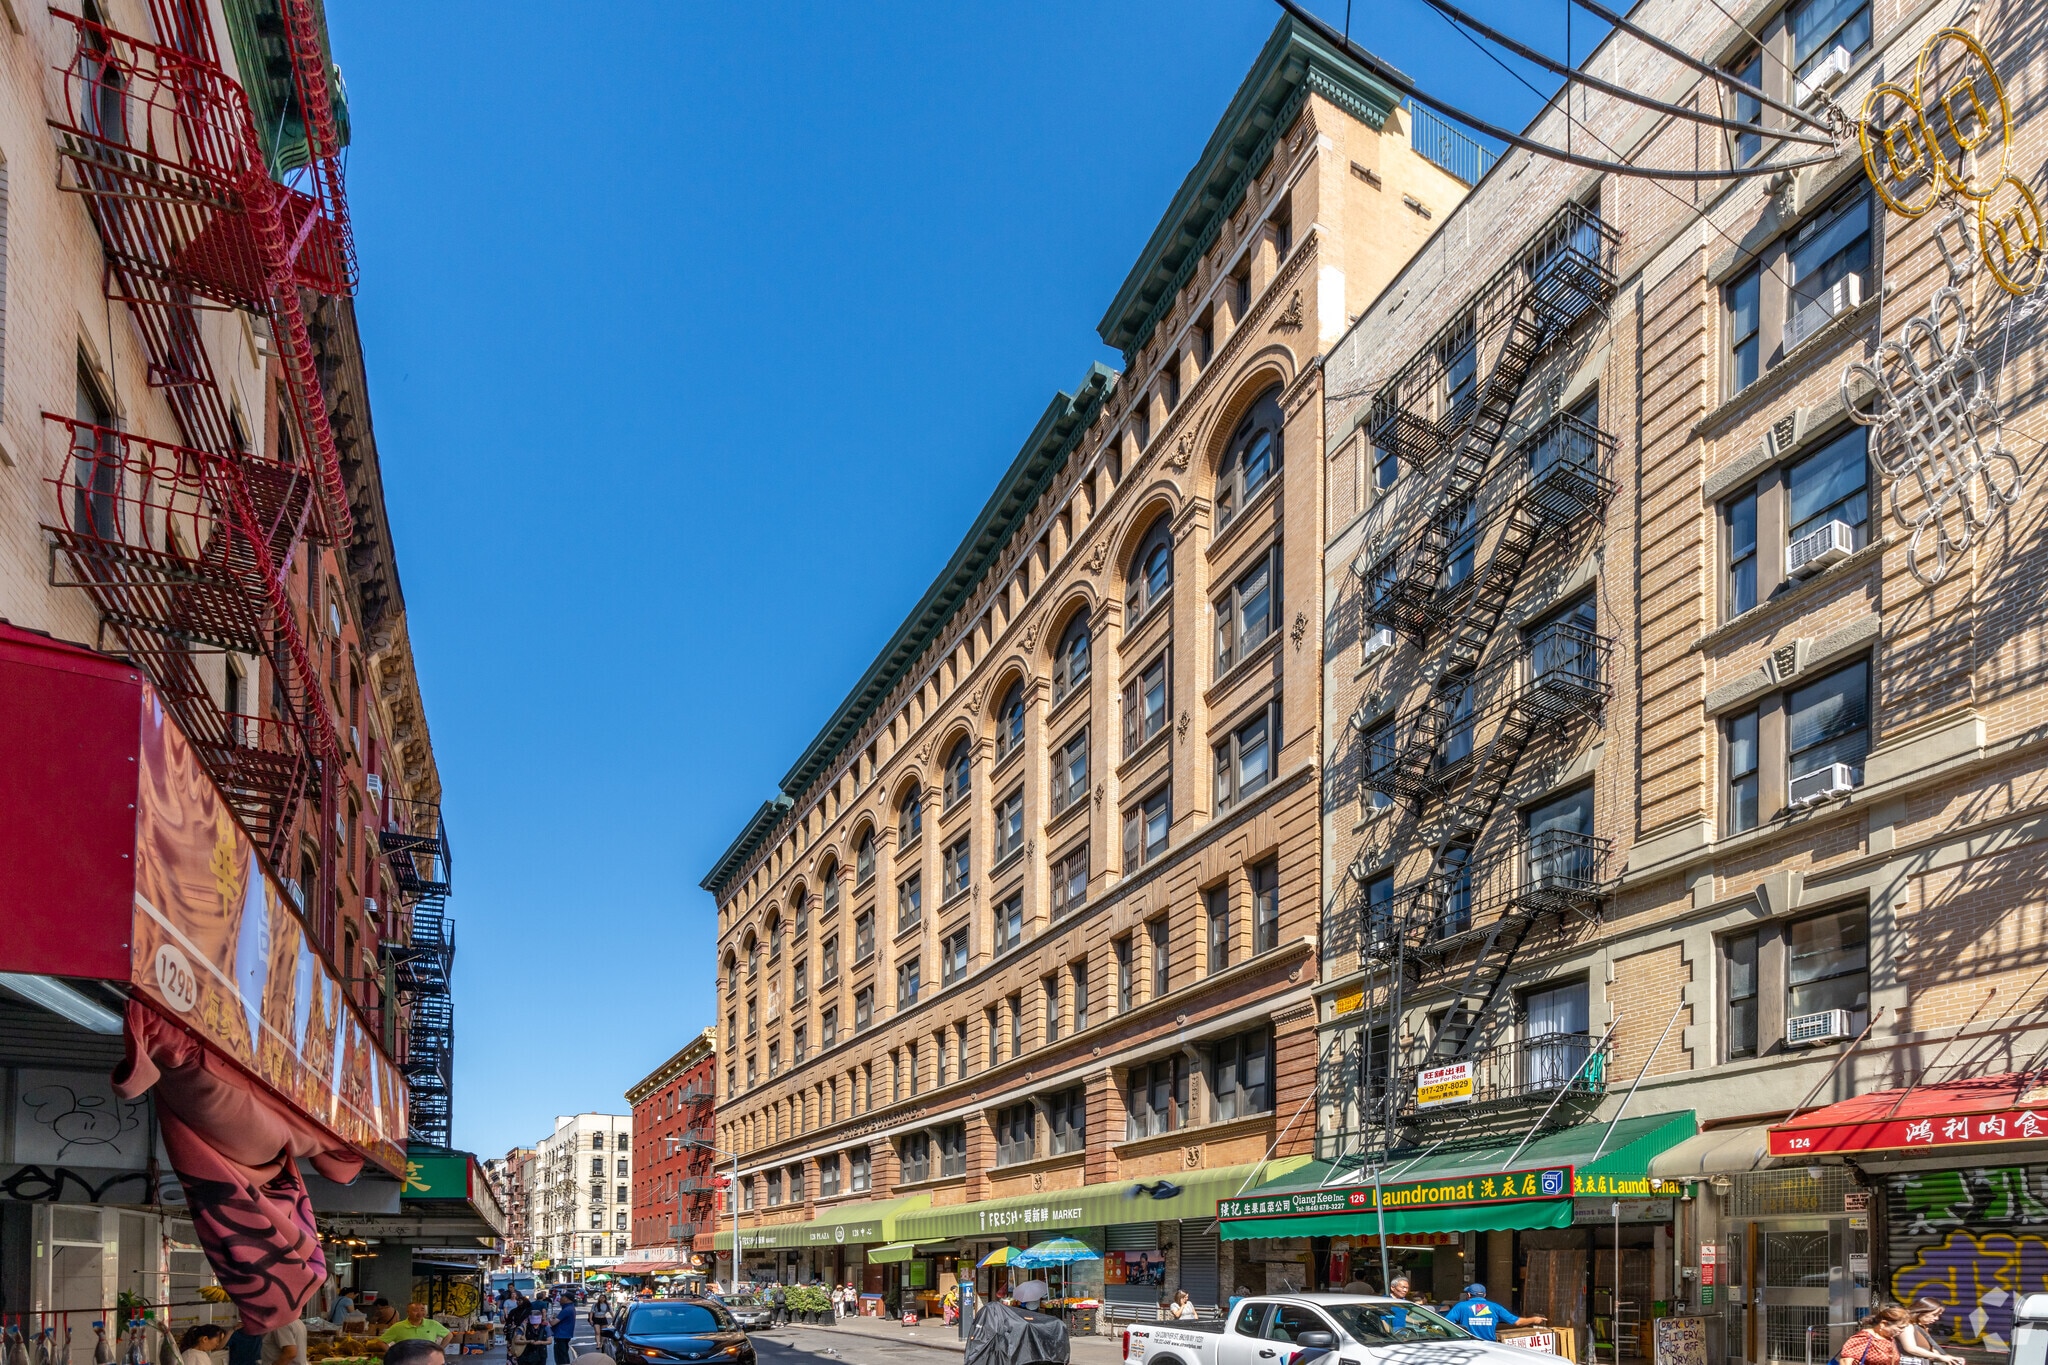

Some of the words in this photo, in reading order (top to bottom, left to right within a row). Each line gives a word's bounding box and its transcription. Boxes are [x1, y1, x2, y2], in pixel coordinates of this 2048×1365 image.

[158, 953, 196, 1006] 129B
[1421, 1081, 1468, 1095] 917-297-8029
[1789, 1137, 1810, 1149] 124
[1372, 1181, 1474, 1206] Laundromat
[1480, 1173, 1537, 1198] 洗衣店
[1574, 1176, 1606, 1193] 洗衣店
[1292, 1195, 1316, 1206] Qiang
[1317, 1193, 1333, 1203] Kee
[1333, 1193, 1345, 1201] Inc.
[1350, 1194, 1365, 1203] 126
[989, 1210, 1018, 1228] FRESH
[1052, 1207, 1082, 1220] MARKET
[816, 1232, 830, 1240] PLAZA
[1529, 1335, 1541, 1348] JIE
